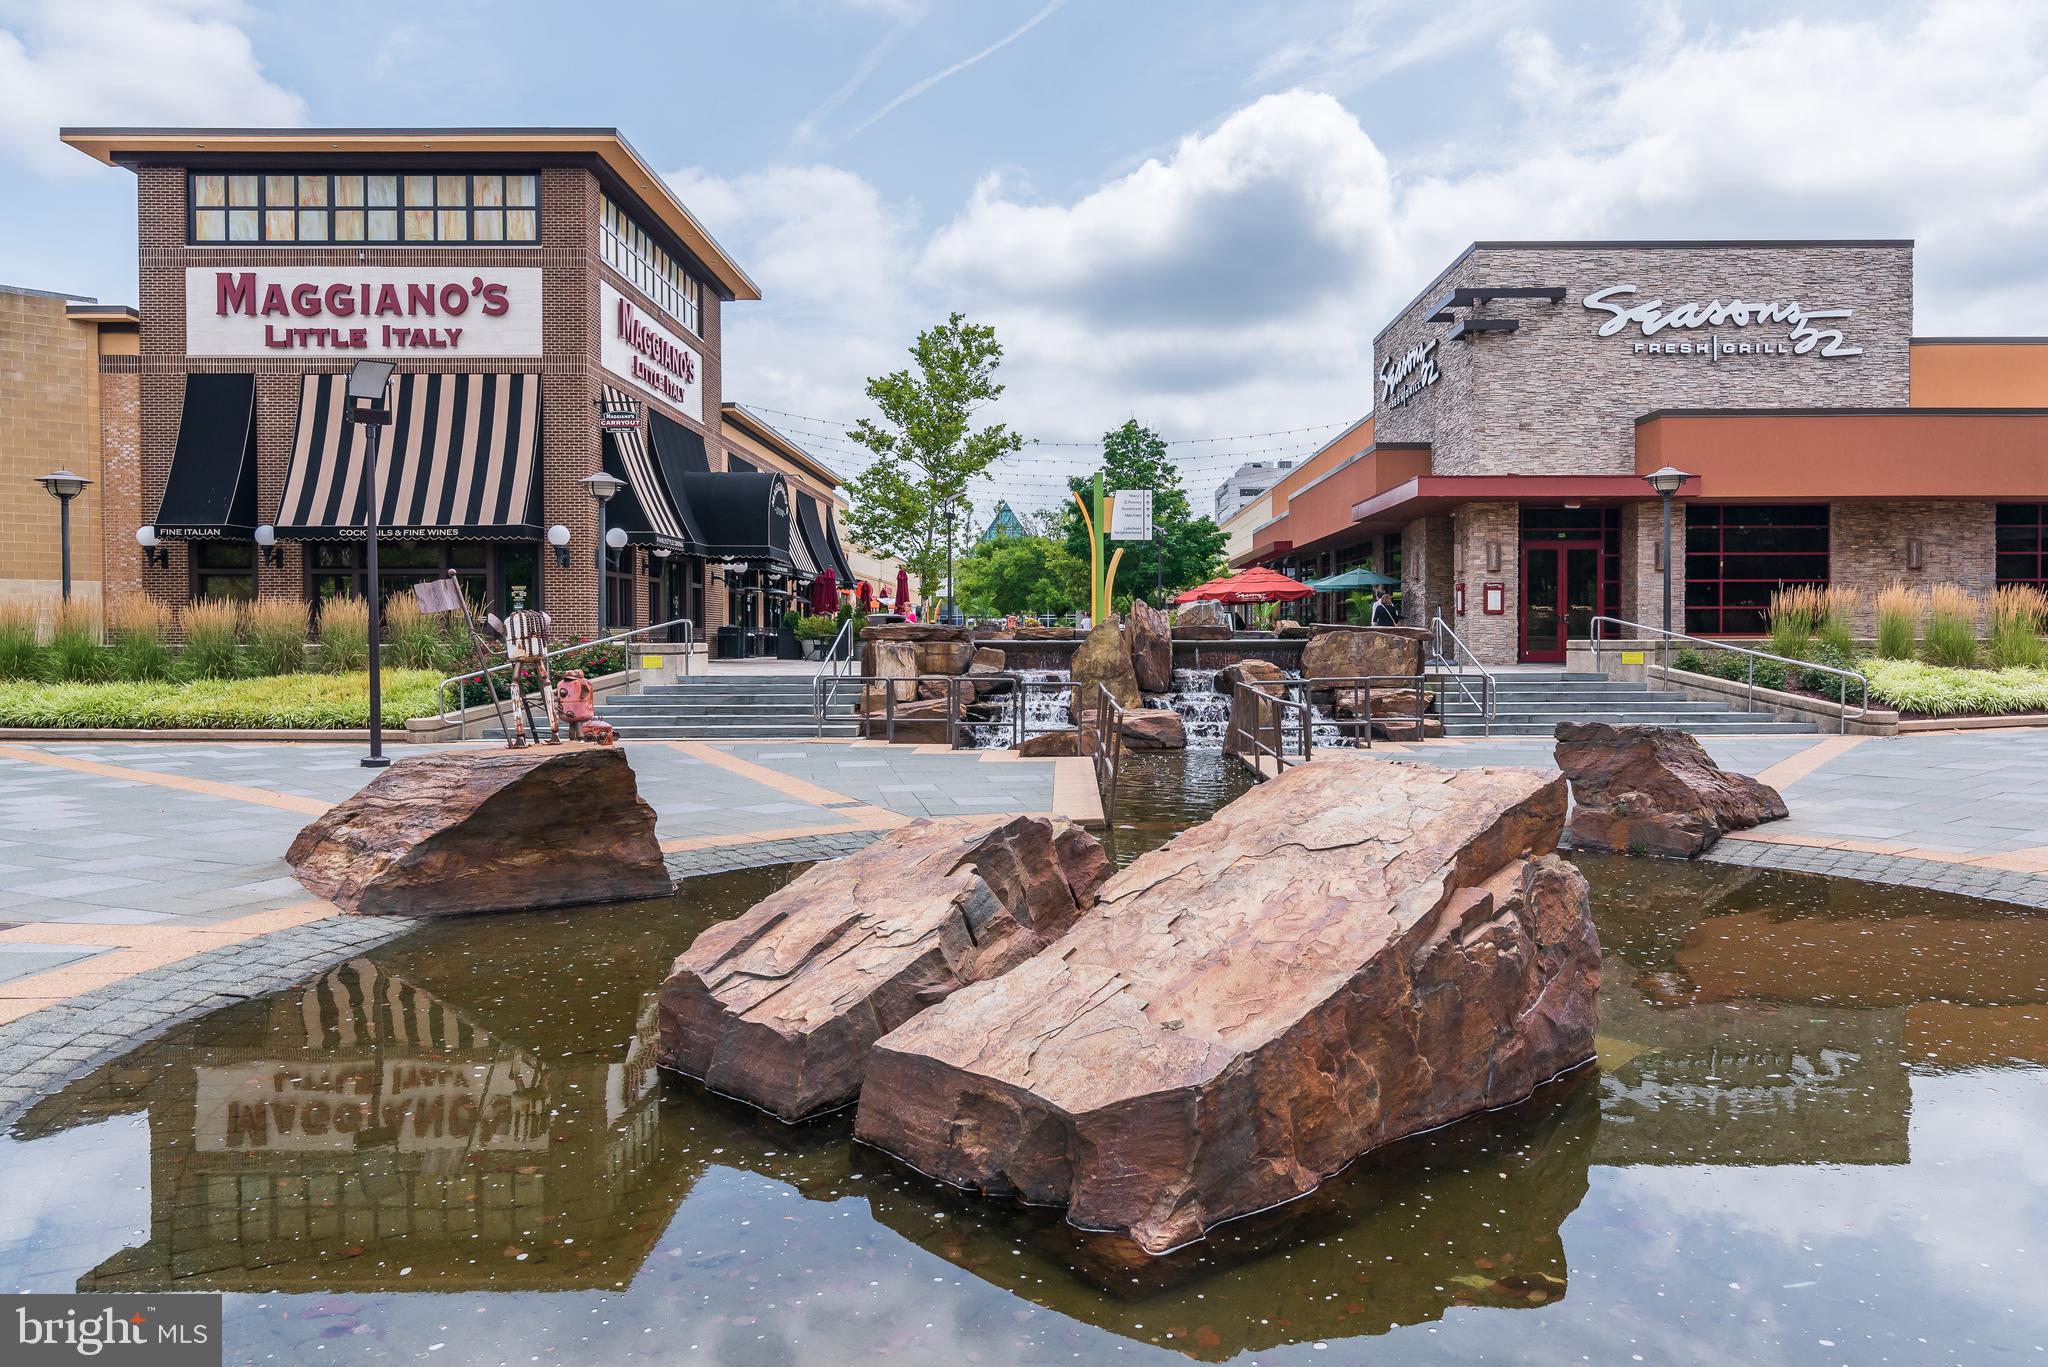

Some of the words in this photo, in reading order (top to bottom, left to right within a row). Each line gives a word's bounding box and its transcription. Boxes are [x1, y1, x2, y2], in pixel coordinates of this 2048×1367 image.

[216, 272, 509, 317] MAGGIANO'S
[264, 324, 367, 348] LITTLE
[382, 324, 463, 348] ITALY
[1583, 284, 1853, 337] Seasons
[1789, 318, 1864, 357] 52
[617, 297, 696, 385] MAGGIANO'S
[1634, 342, 1710, 354] FRESH
[1722, 342, 1788, 354] GRILL
[631, 355, 664, 391] LITTLE
[663, 374, 685, 403] ITALY
[160, 528, 182, 536] FINE
[184, 528, 221, 536] ITALIAN
[427, 528, 459, 536] WINES
